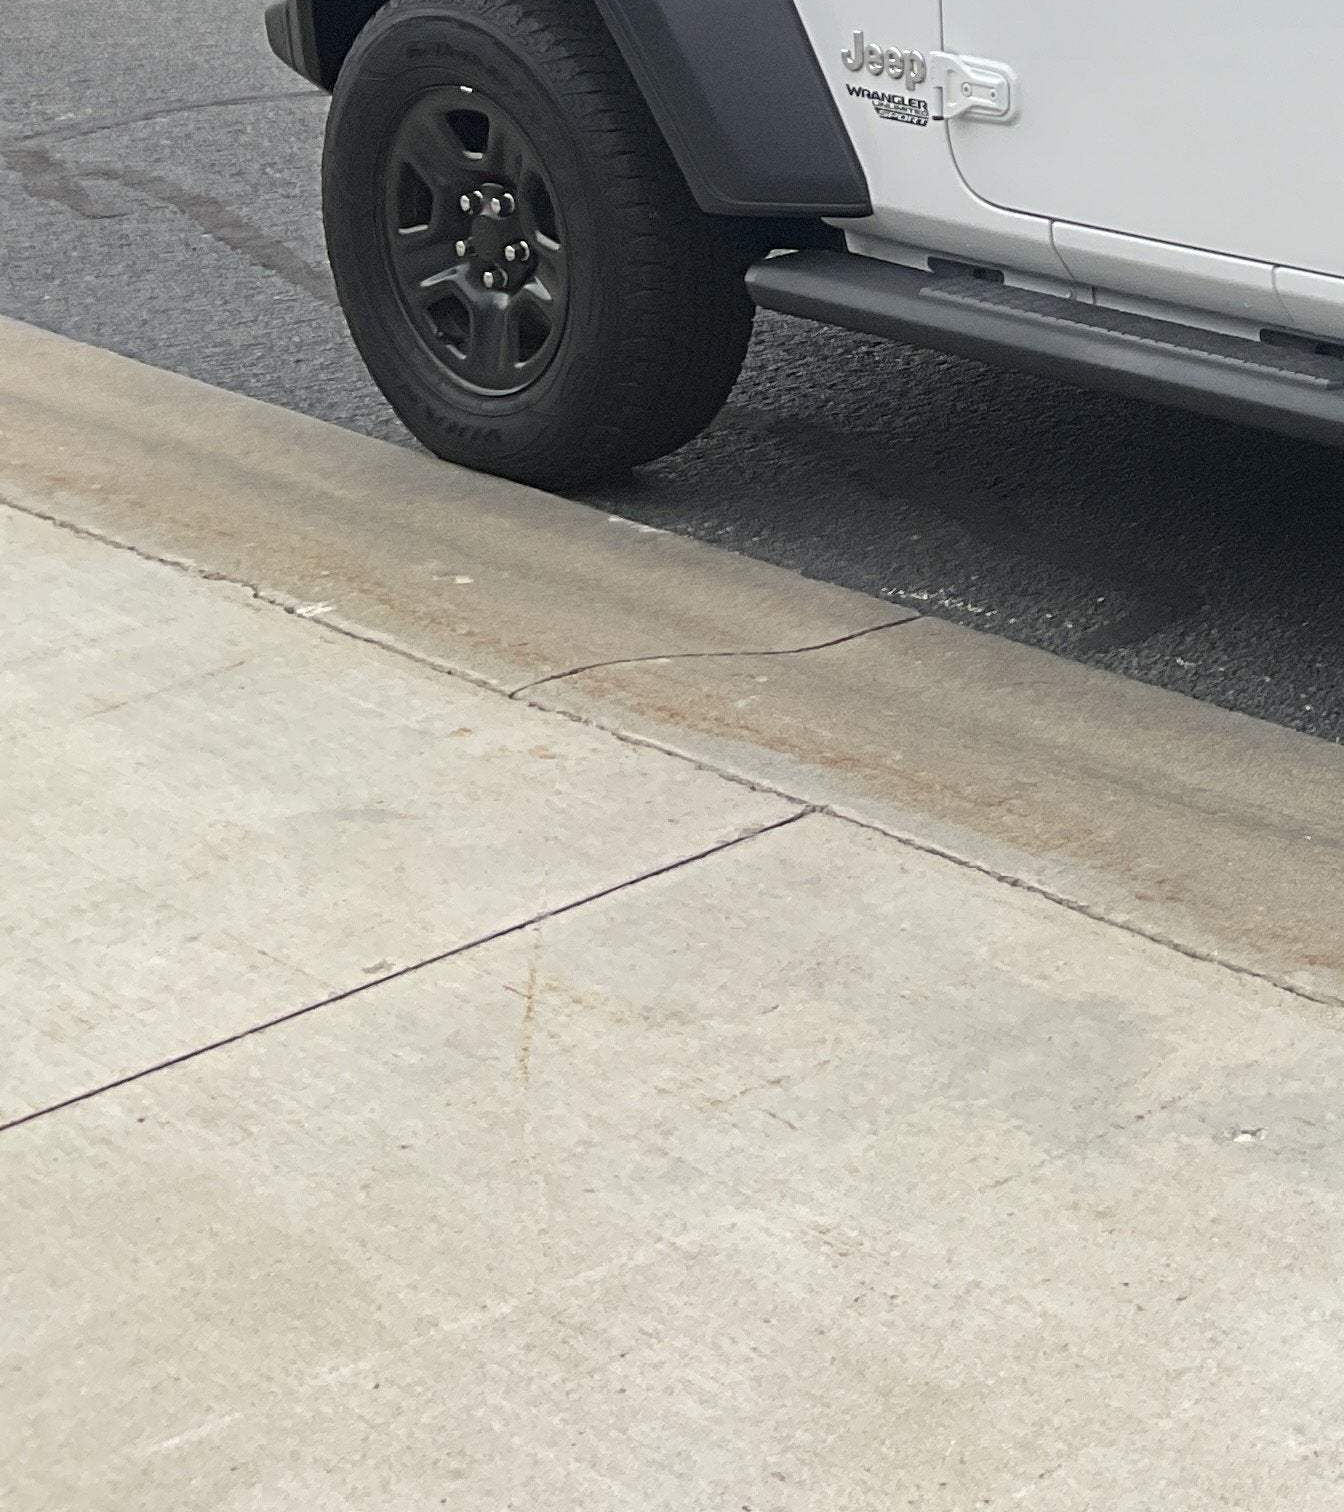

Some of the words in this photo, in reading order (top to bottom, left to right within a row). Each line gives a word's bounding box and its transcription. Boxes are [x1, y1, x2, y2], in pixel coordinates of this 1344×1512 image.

[840, 28, 927, 91] Jeep
[845, 83, 928, 110] WRANGLER
[878, 109, 928, 126] SPORT
